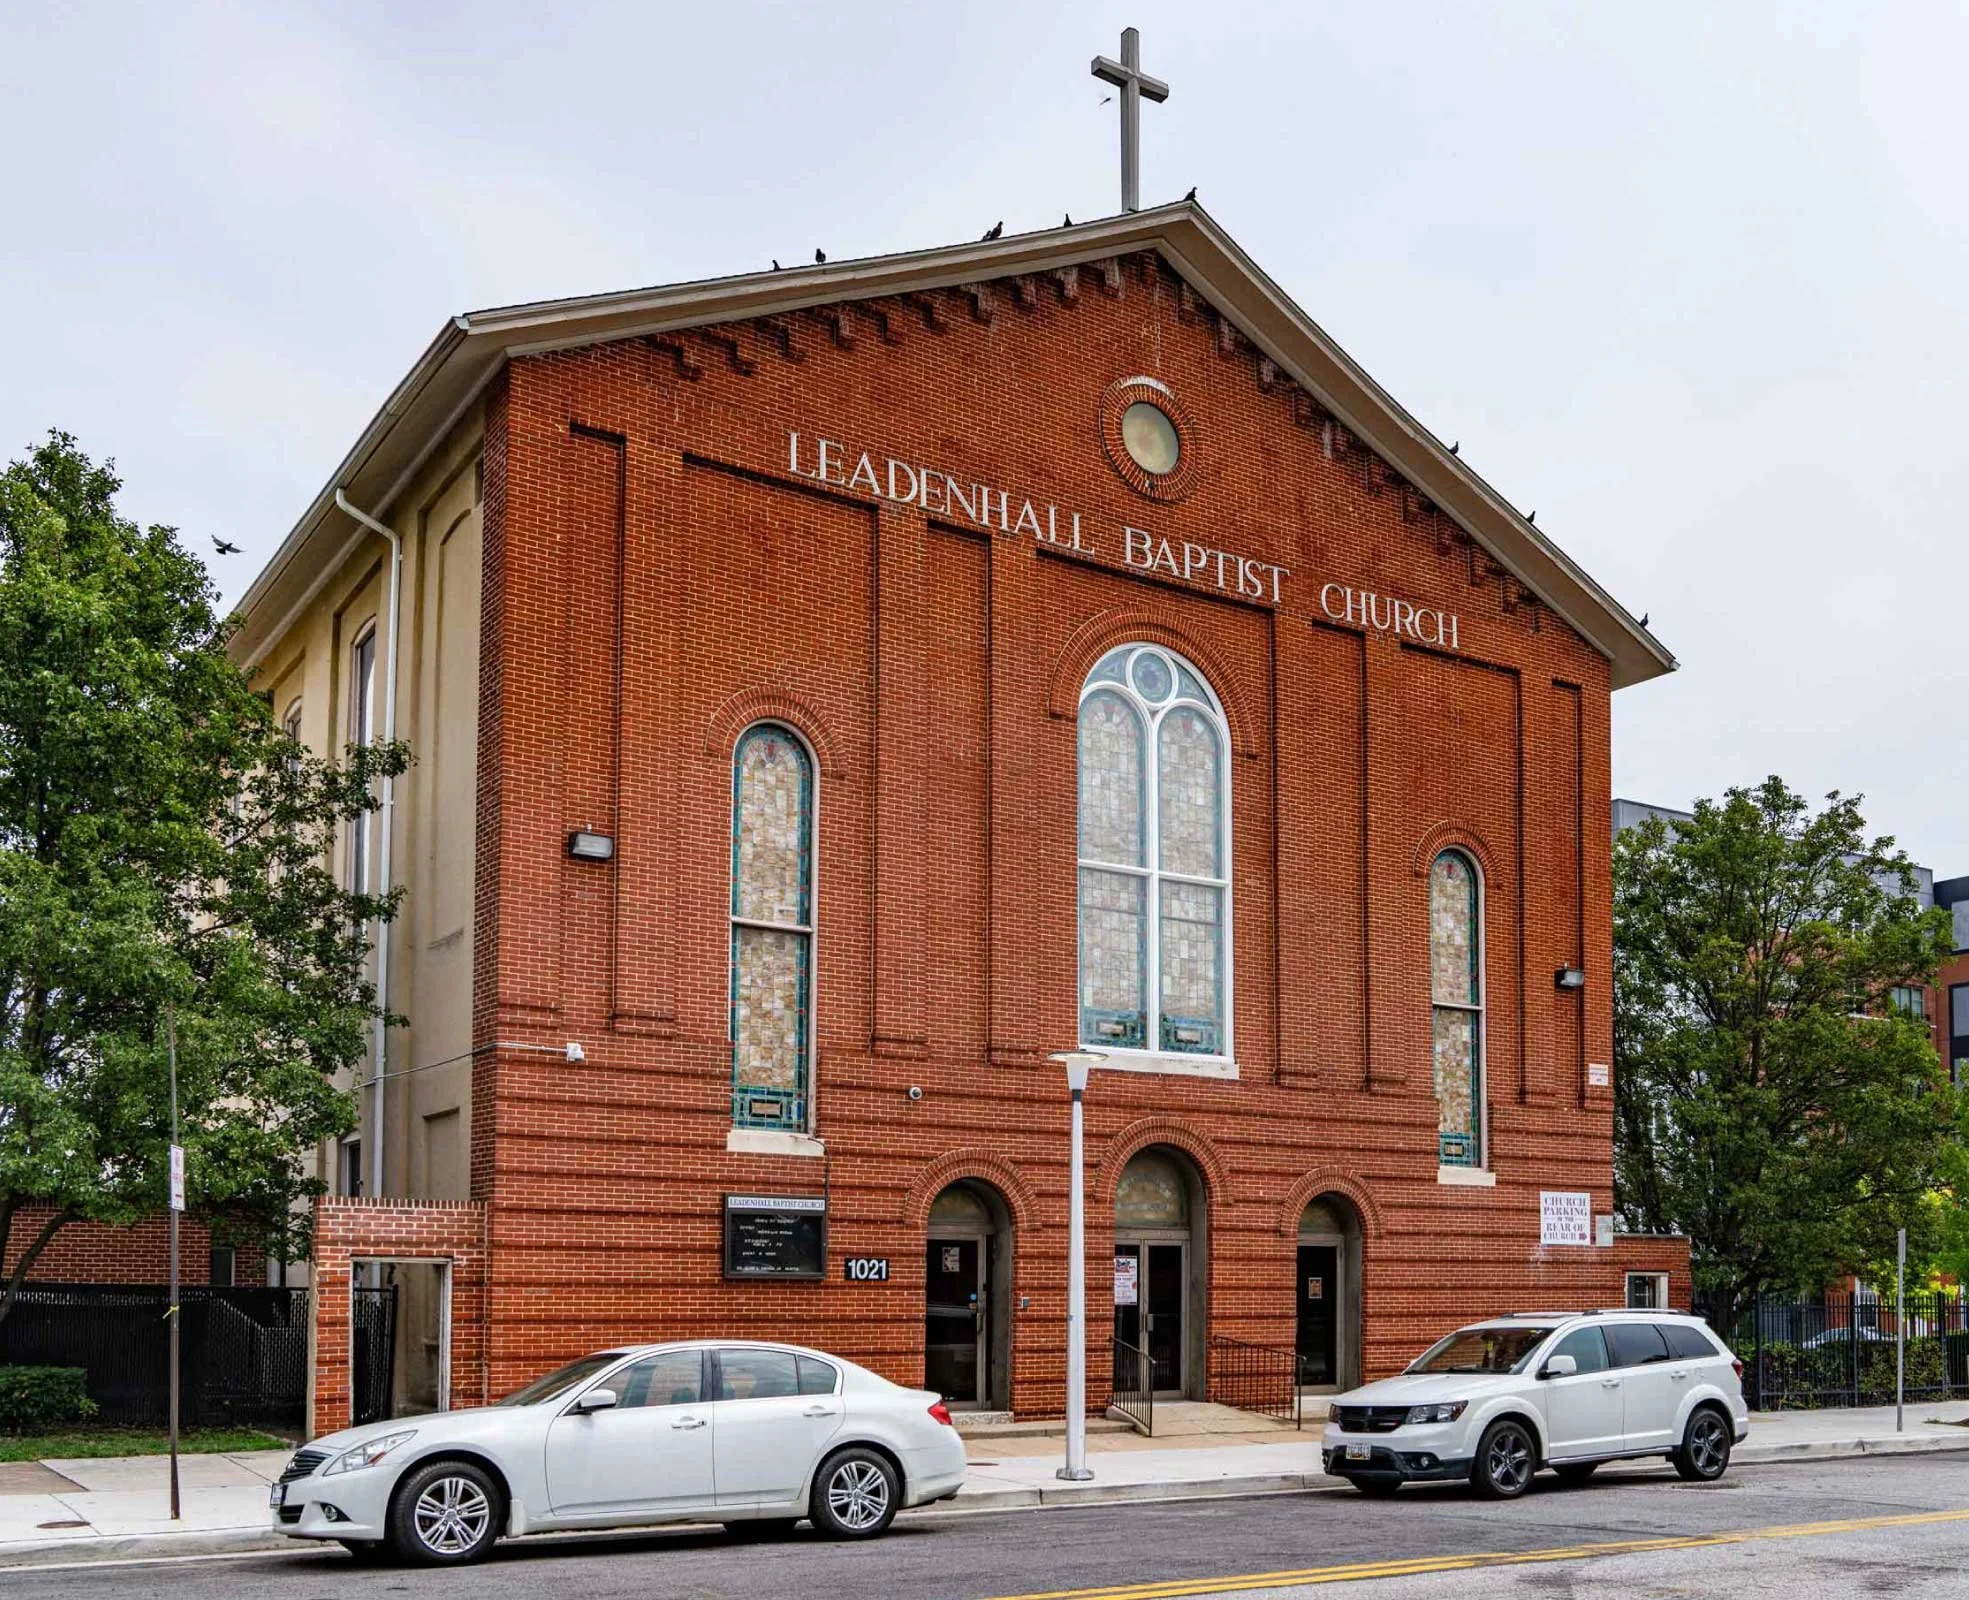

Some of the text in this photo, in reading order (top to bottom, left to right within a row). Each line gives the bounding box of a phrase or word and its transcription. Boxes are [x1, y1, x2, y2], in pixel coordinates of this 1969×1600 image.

[787, 431, 1460, 649] LEADENHALL BAPTIST CHURCH
[729, 1198, 772, 1207] LEADENHALL
[798, 1200, 824, 1209] CHURCH
[1544, 1197, 1586, 1207] CHURCH
[1543, 1207, 1587, 1216] PARKING
[1546, 1223, 1584, 1232] REAR OF
[1544, 1232, 1576, 1241] CHURCH
[848, 1259, 887, 1280] 1021
